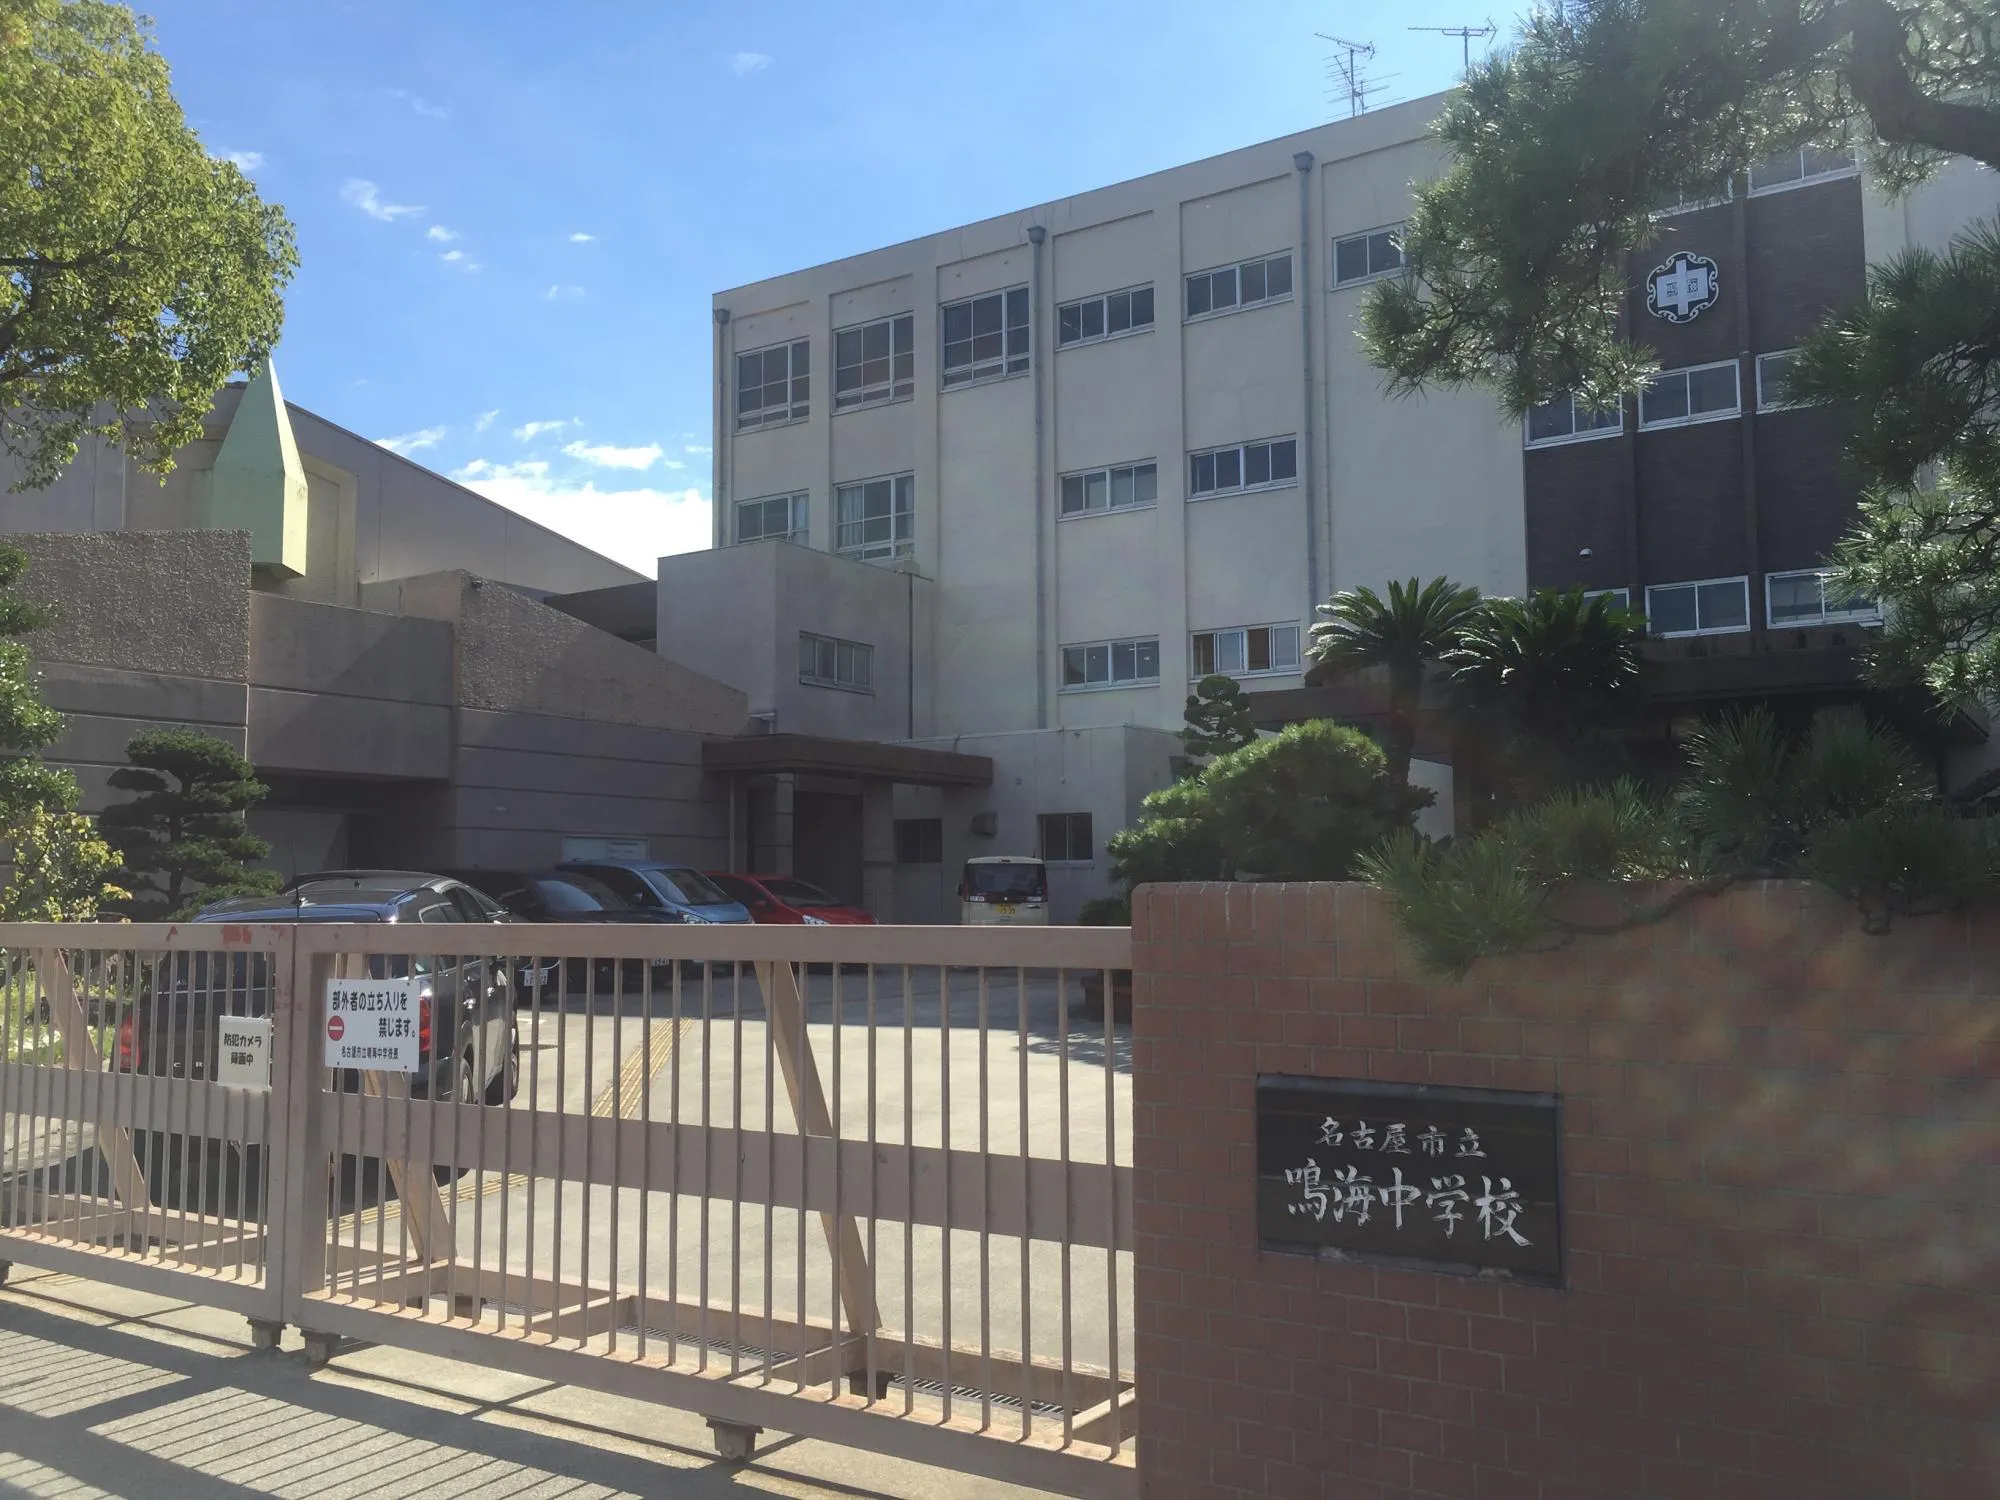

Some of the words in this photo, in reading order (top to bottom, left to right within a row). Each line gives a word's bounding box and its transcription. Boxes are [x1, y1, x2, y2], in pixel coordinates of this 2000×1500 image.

[332, 990, 408, 1012] 部外者の立ち入りを
[378, 1017, 415, 1038] 禁じます。
[223, 1032, 262, 1048] 防犯カメラ
[230, 1051, 254, 1067] 録画中
[1314, 1115, 1488, 1158] 名古屋市立
[1284, 1157, 1533, 1247] 鳴海中学校
